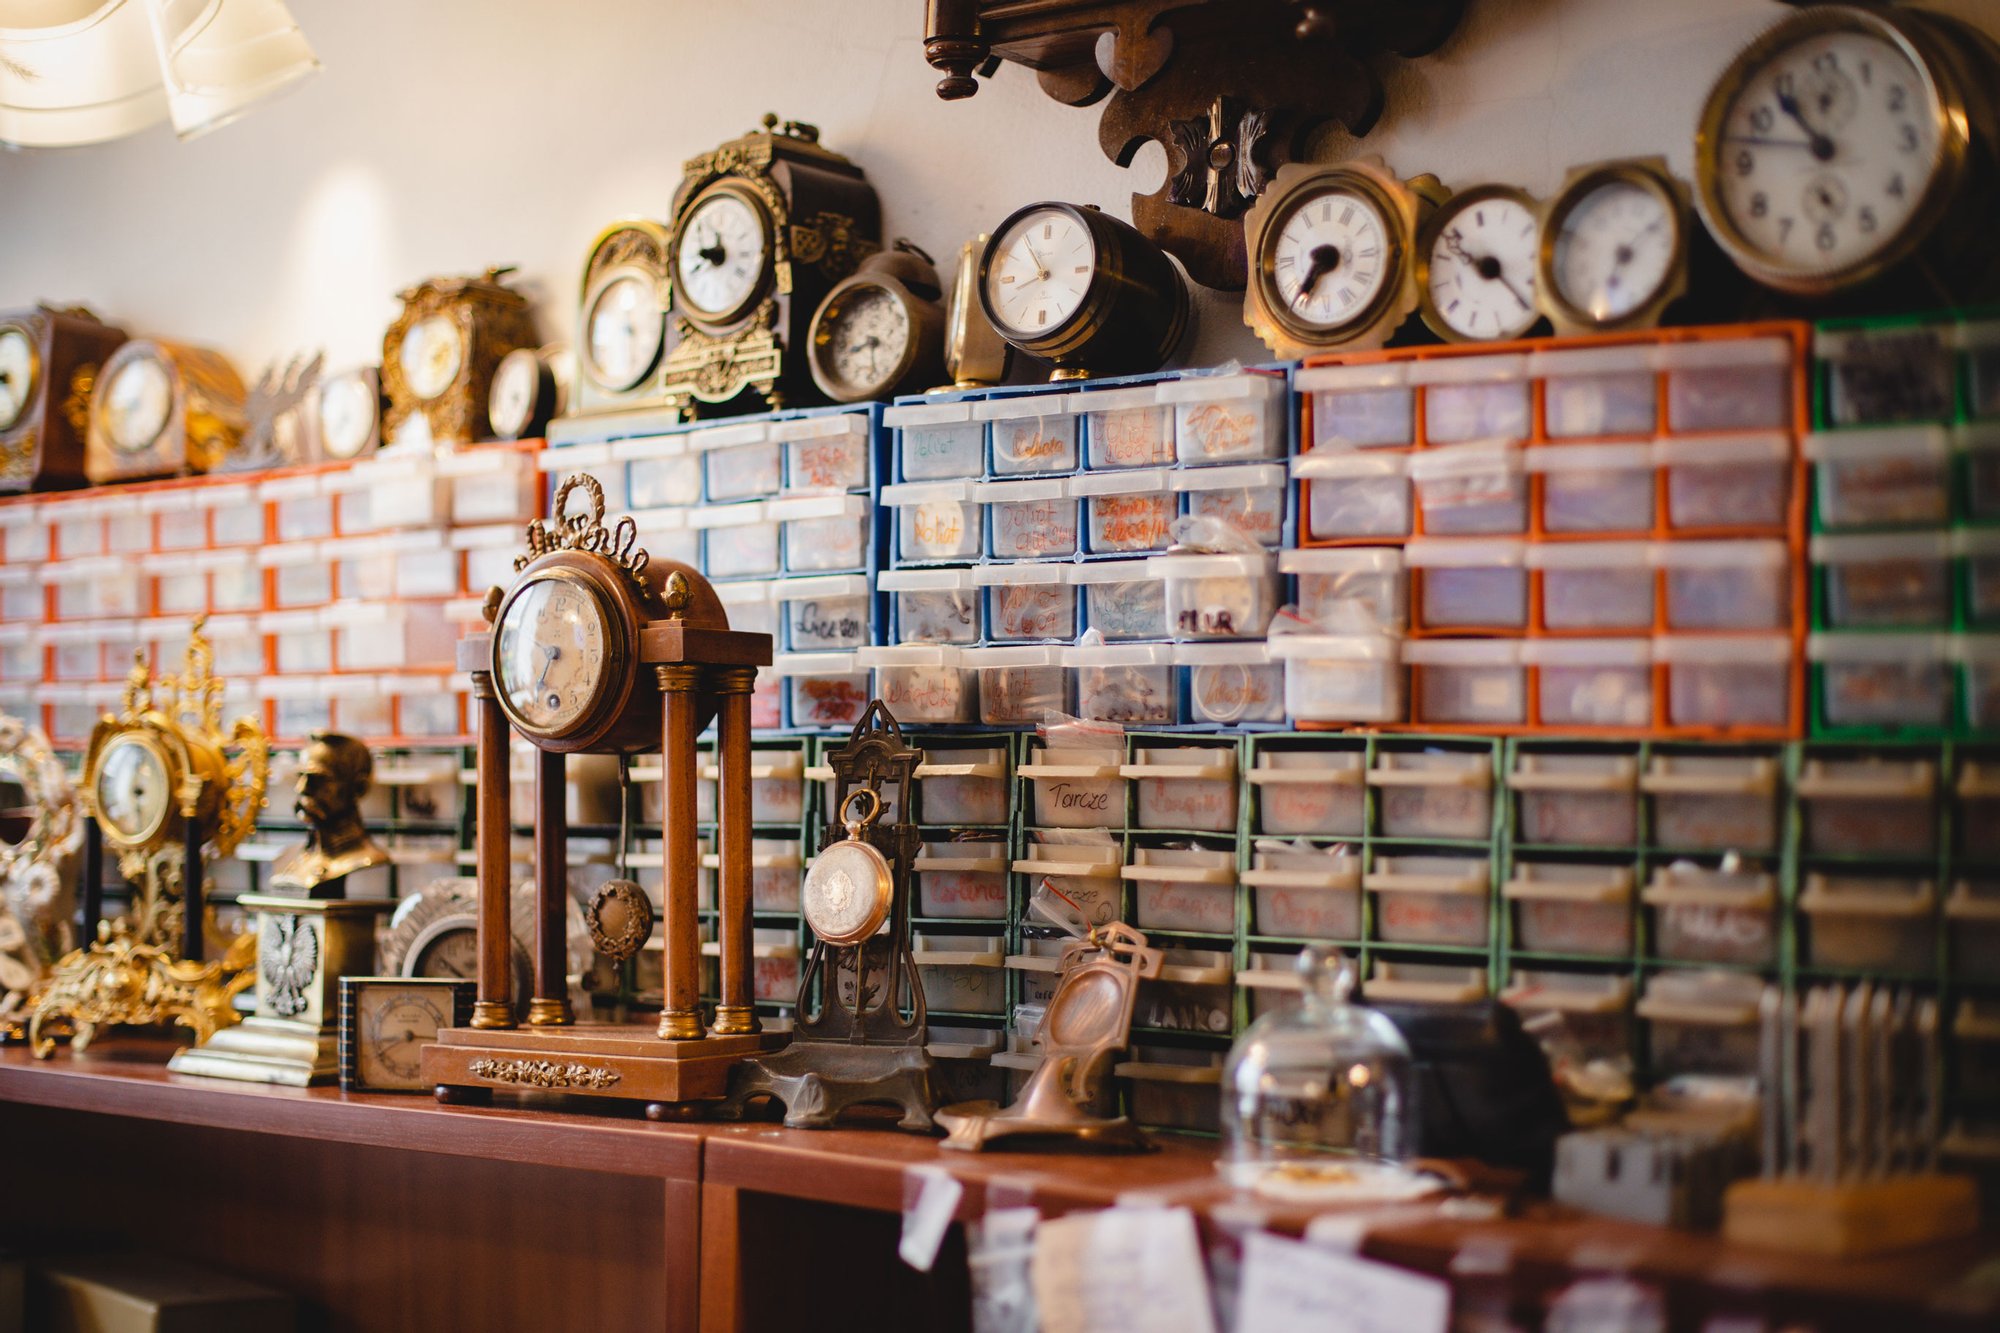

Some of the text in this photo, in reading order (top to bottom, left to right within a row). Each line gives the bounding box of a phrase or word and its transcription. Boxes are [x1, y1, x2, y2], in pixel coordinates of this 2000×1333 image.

[587, 622, 596, 637] 2
[589, 648, 599, 665] 3
[583, 671, 591, 687] 4
[569, 690, 578, 706] 5
[1048, 783, 1110, 812] Tarcze
